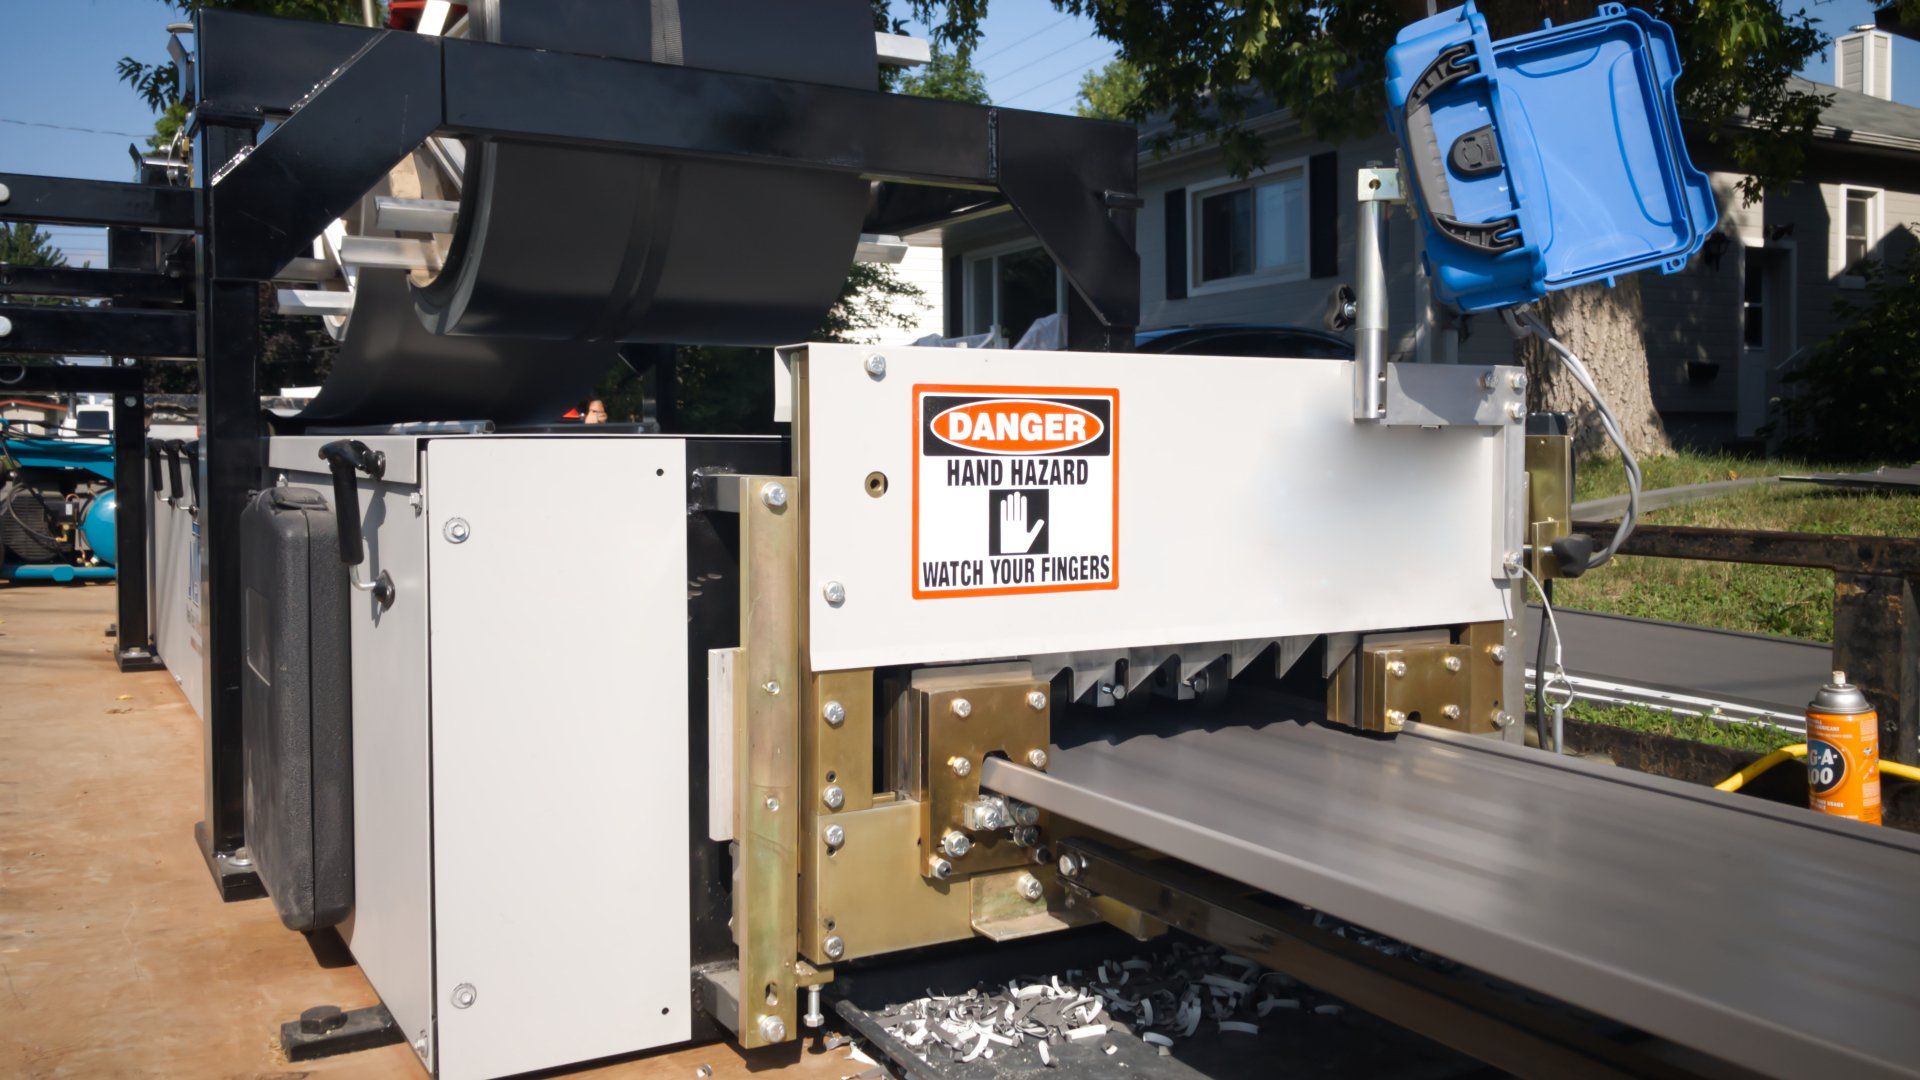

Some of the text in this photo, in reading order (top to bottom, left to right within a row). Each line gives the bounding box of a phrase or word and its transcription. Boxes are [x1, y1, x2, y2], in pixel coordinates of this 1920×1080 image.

[948, 412, 1086, 441] DANGER
[947, 458, 1088, 486] HAND HAZARD
[923, 554, 1110, 587] WATCH YOUR FINGERS
[1808, 748, 1838, 766] G-A-
